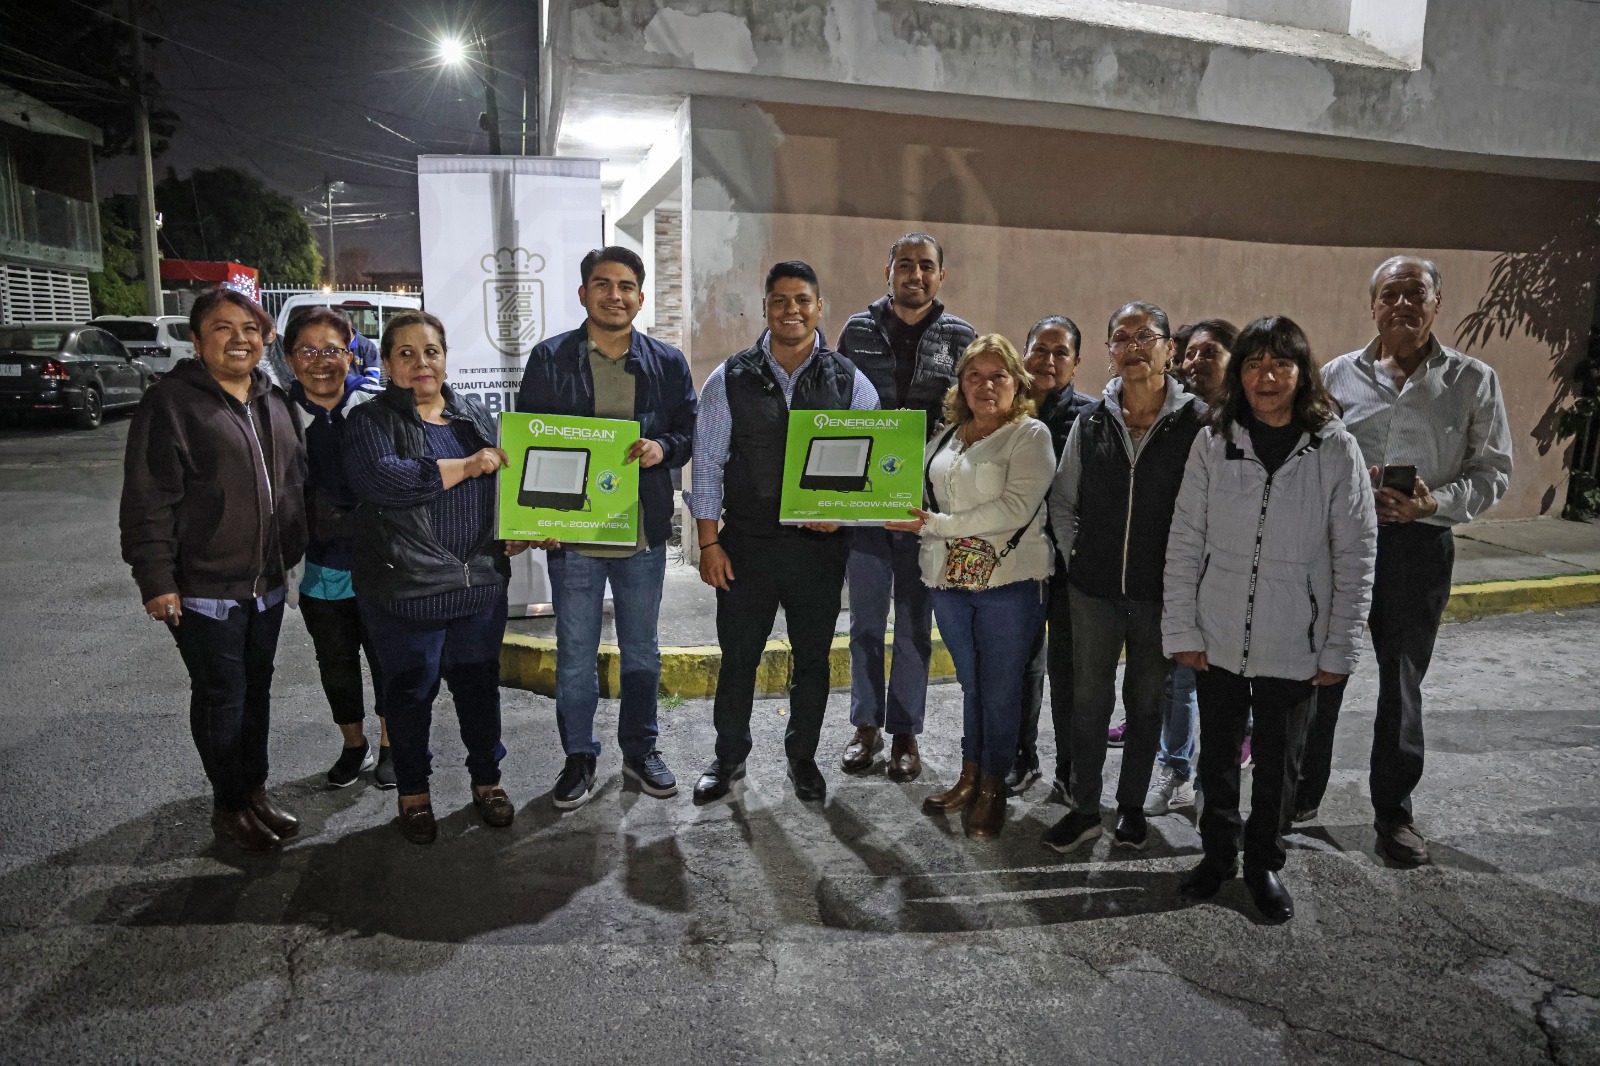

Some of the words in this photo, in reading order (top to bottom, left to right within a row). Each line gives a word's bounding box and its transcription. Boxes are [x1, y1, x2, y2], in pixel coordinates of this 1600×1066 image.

[828, 418, 899, 427] ENERGAIN
[544, 425, 615, 439] ENERGAIN
[817, 500, 913, 508] EG-FL-200W-MEKA
[607, 512, 629, 520] LED
[537, 519, 630, 530] EG-FL-200W-MEKA
